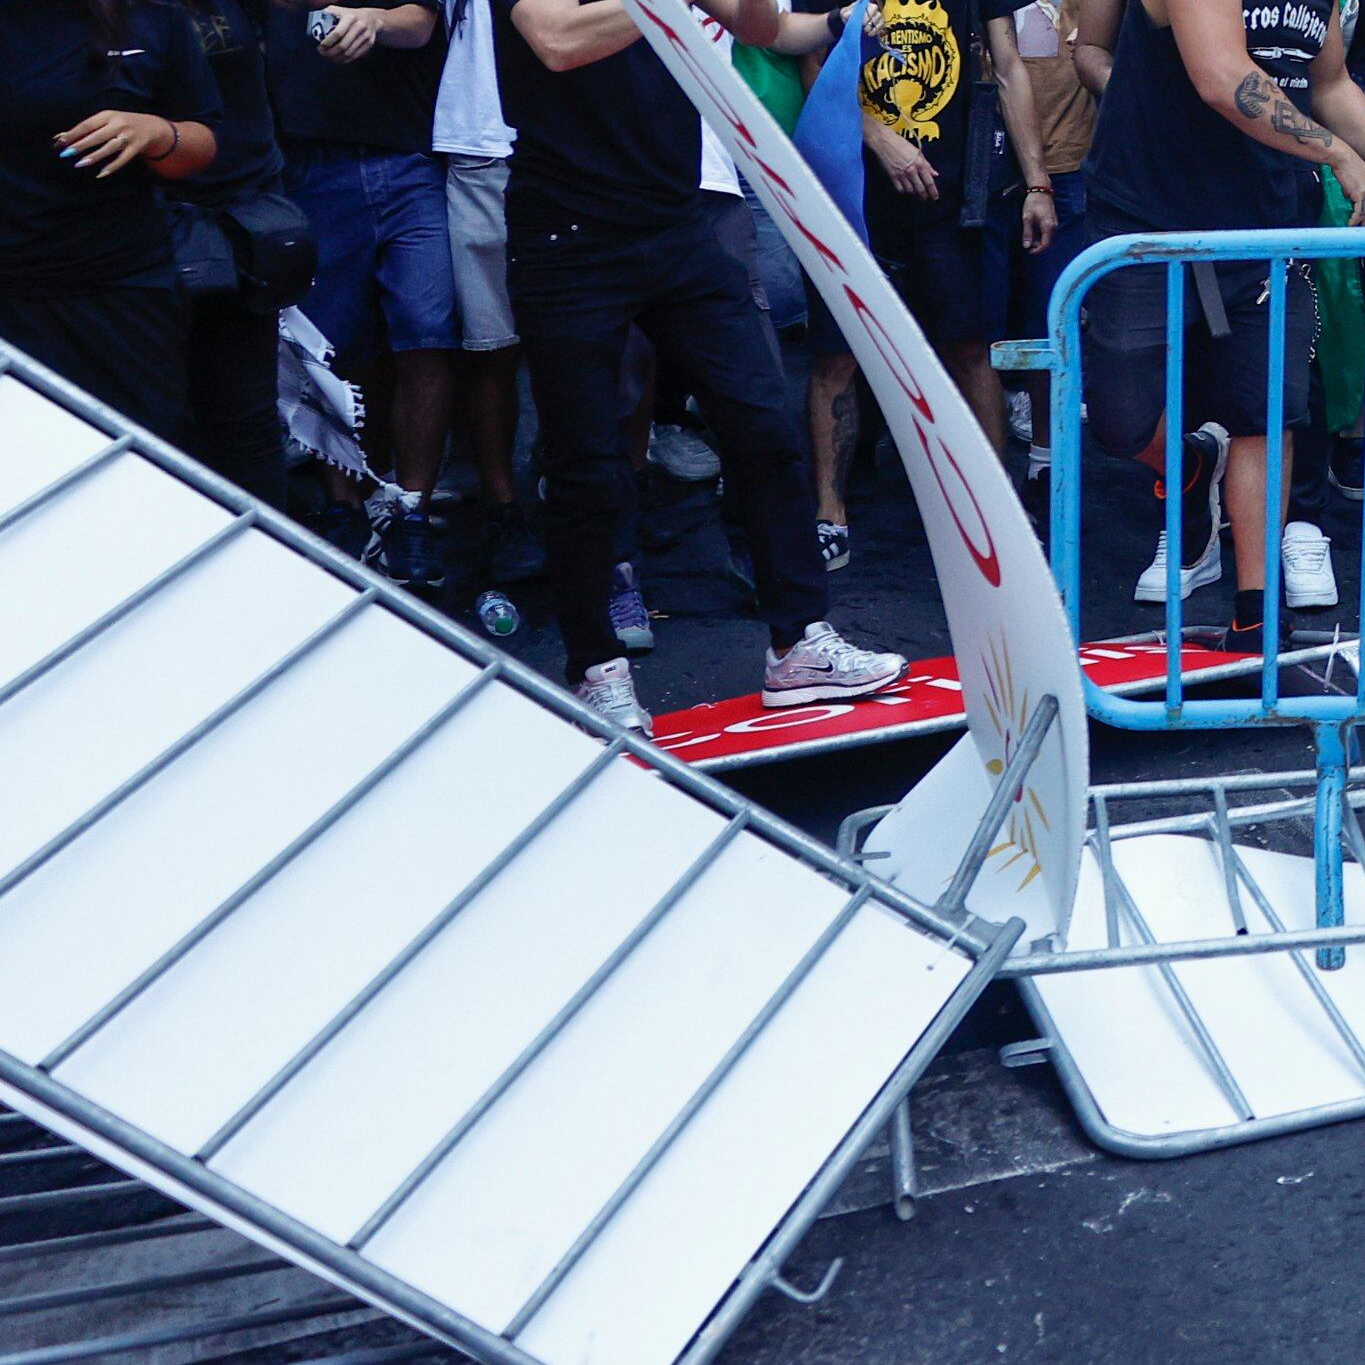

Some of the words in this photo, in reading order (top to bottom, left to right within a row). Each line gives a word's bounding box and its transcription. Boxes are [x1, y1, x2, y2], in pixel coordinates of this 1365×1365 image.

[1242, 6, 1280, 30] rros
[891, 29, 933, 45] RENTISMO
[902, 45, 913, 53] ES
